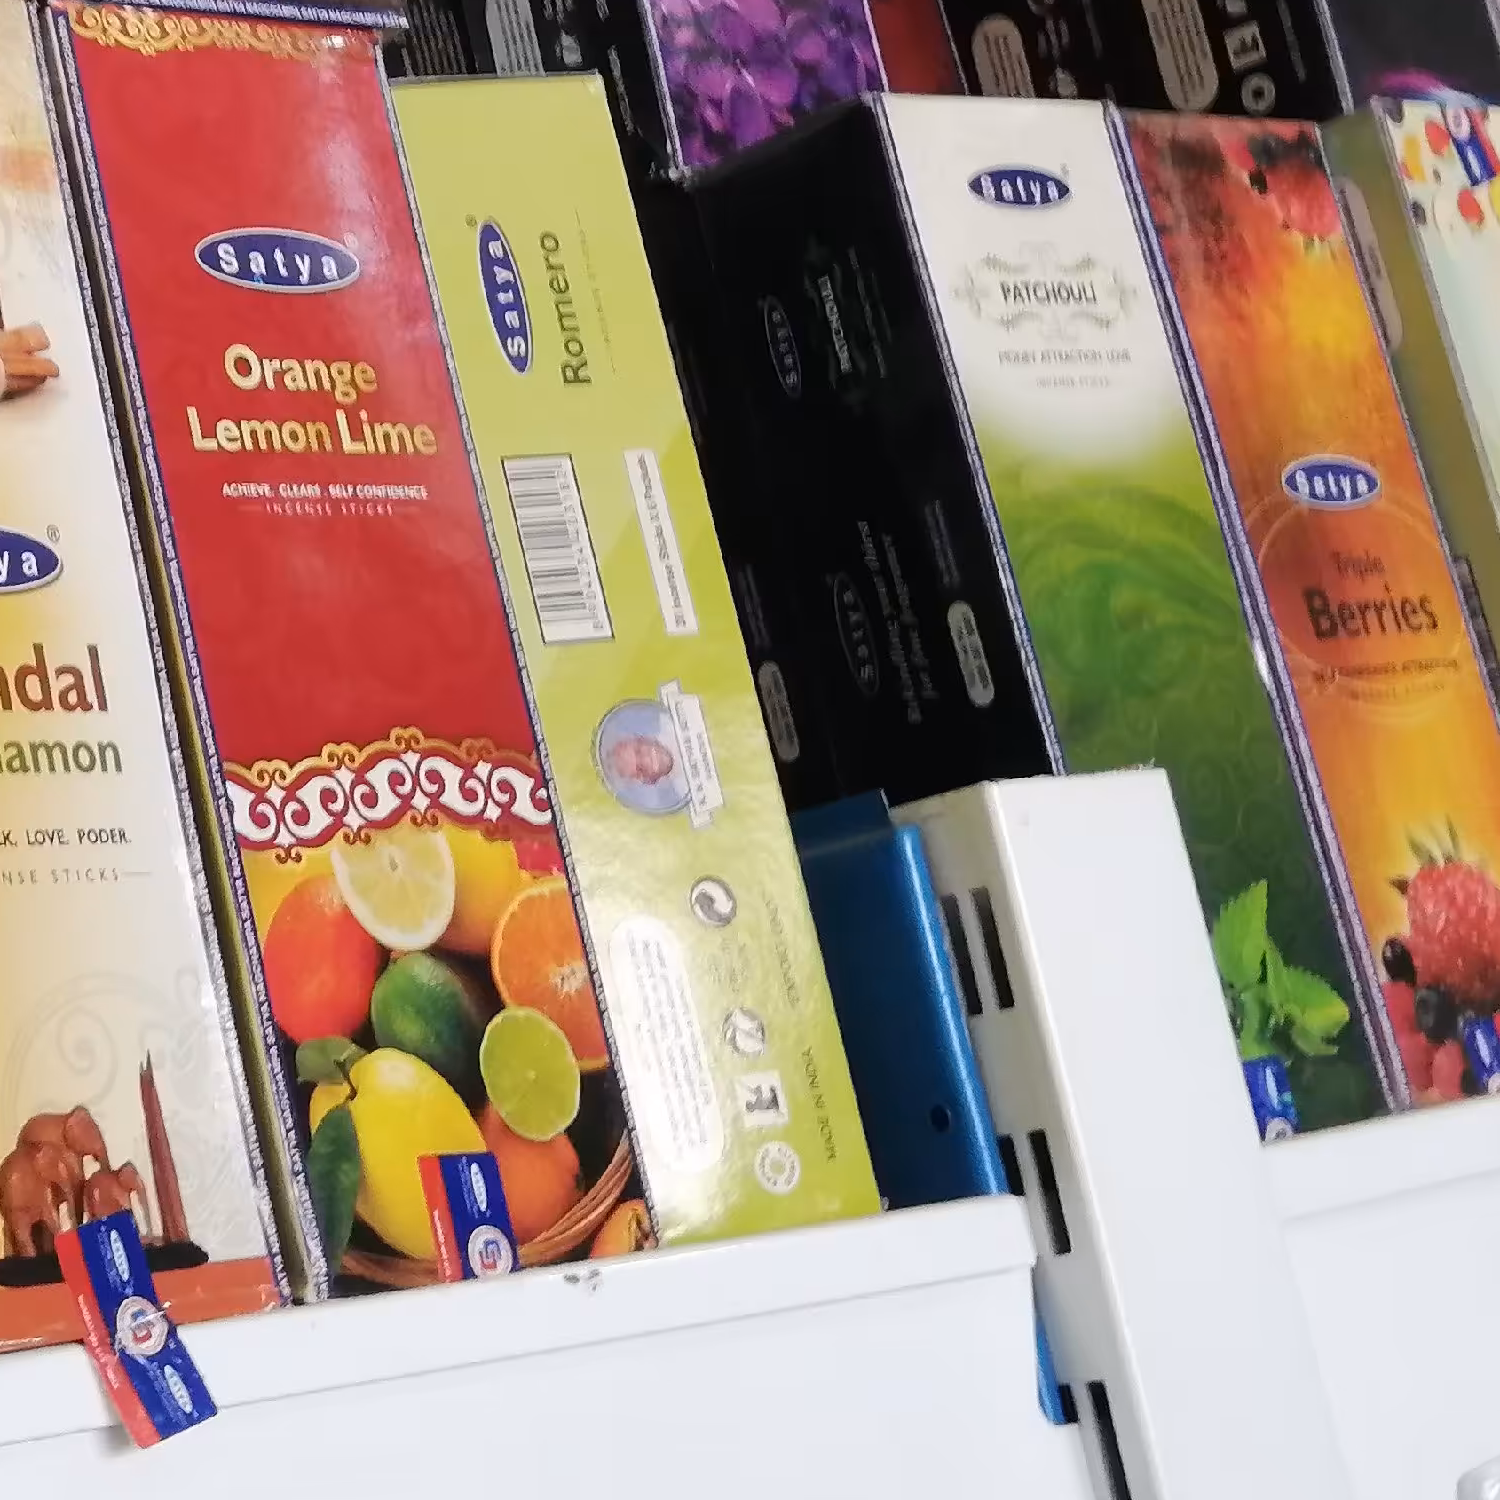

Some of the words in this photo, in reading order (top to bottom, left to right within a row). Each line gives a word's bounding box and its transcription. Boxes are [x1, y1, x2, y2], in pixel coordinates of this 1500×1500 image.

[216, 242, 340, 286] Satya
[487, 239, 526, 360] Satya
[538, 230, 592, 386] Romero
[224, 342, 378, 406] Orange
[186, 405, 335, 452] Lemon
[335, 408, 439, 456] Lime
[1302, 584, 1440, 643] Berries
[51, 866, 120, 885] STICKS
